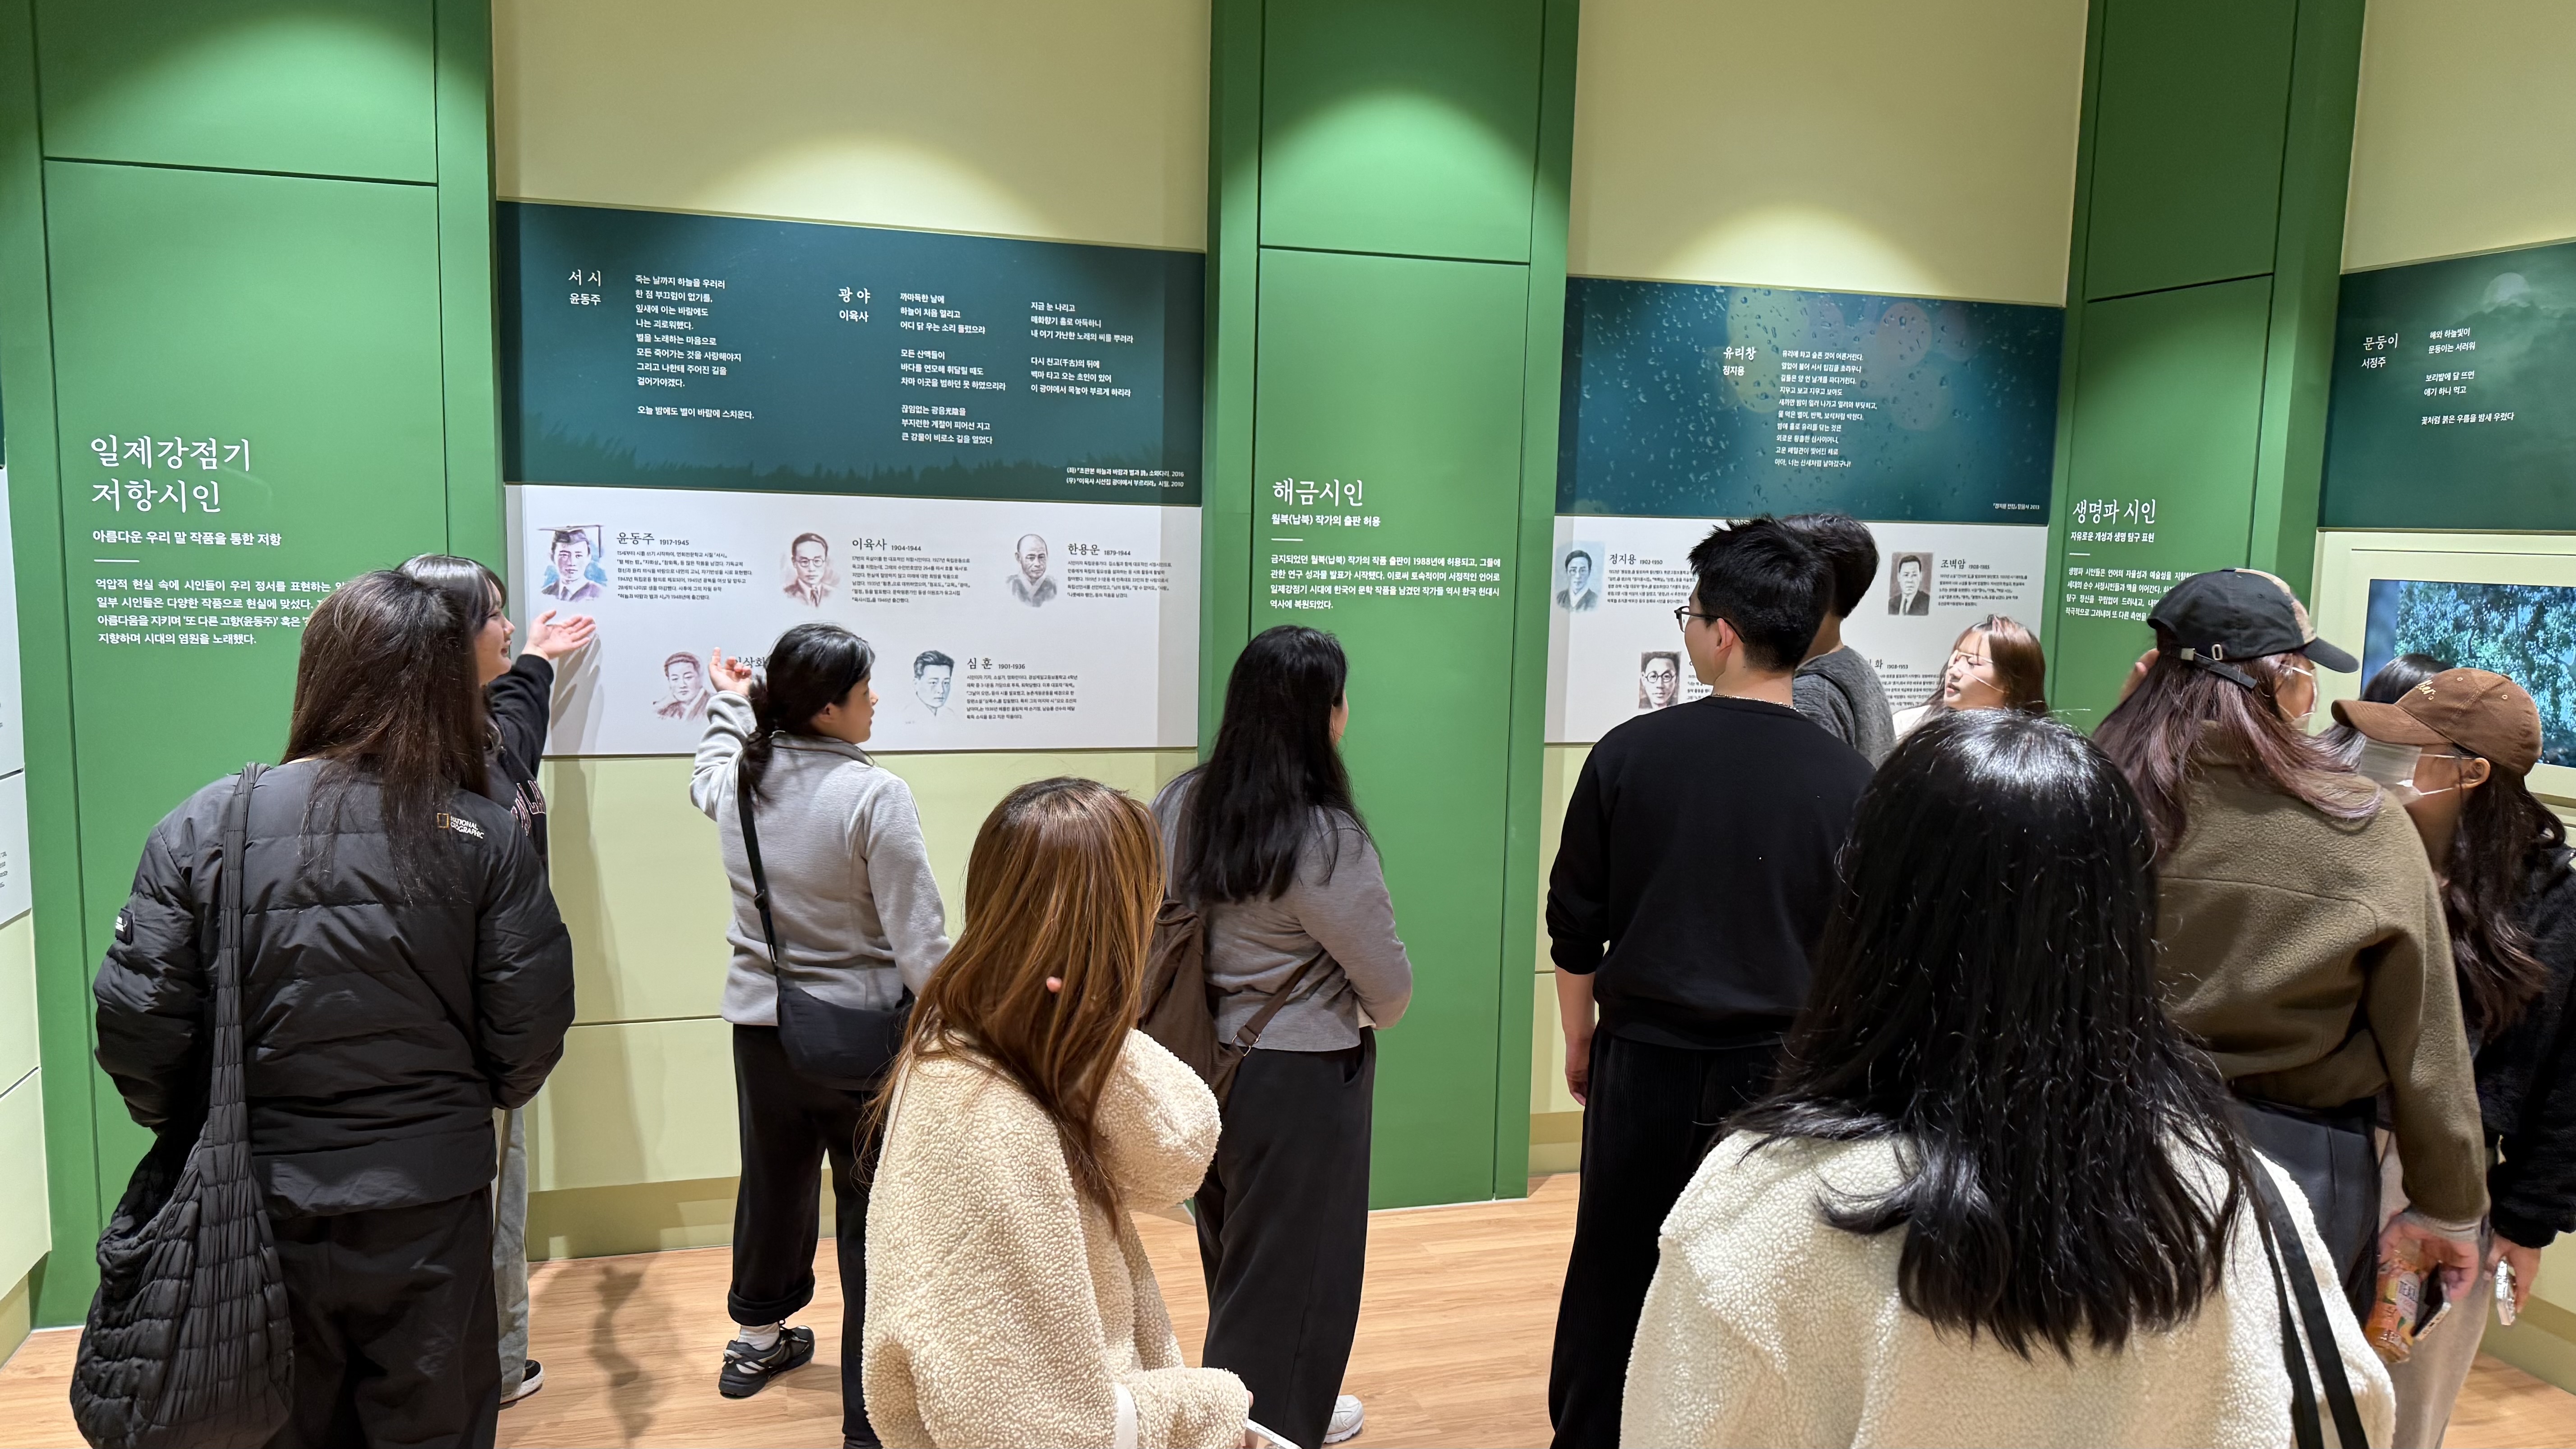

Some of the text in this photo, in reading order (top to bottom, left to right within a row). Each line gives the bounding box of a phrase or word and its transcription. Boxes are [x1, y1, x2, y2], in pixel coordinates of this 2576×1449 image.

[635, 274, 725, 289] 죽는 날까지 하늘을 우러러
[569, 292, 601, 306] 윤동주
[635, 289, 643, 298] 한
[645, 290, 653, 299] 점
[655, 290, 685, 301] 부끄럼이
[900, 292, 944, 304] 까마득한 날에
[635, 304, 708, 316] 잎새에 이는 바람에도
[839, 309, 869, 322] 이육사
[635, 318, 694, 330] 나는 괴로워했다.
[900, 321, 915, 330] 어디
[916, 322, 924, 331] 닭
[925, 322, 940, 331] 우는
[941, 323, 956, 333] 소리
[635, 333, 717, 345] 별을 노래하는 마음으로
[2429, 327, 2470, 339] 해와 하늘빛이
[2363, 332, 2398, 350] 문둥이
[2428, 341, 2475, 354] 문둥이는 서러워
[636, 347, 741, 362] 모든 죽어가는 것을 사랑해야지
[1723, 345, 1757, 361] 유리창
[636, 362, 727, 375] 그리고 나한테 주어진 길을
[1030, 356, 1044, 365] 다시
[1086, 359, 1099, 368] 뒤에
[2361, 356, 2386, 369] 서정주
[1030, 370, 1111, 383] 백마 타고 오는 초인이 있어
[1722, 365, 1745, 376] 정지용
[2425, 370, 2475, 382] 보리밭에 달 뜨면
[637, 376, 685, 387] 걸어가야겠다.
[901, 377, 915, 386] 차마
[917, 377, 938, 387] 이곳을
[939, 378, 961, 388] 범하던
[2438, 386, 2452, 396] 하나
[2453, 386, 2466, 395] 먹고
[637, 405, 754, 419] 오늘 밤에도 별이 바람에 스치운다.
[2421, 415, 2441, 425] 꽃처럼
[2442, 414, 2455, 424] 붉은
[2456, 413, 2476, 423] 우름을
[2478, 413, 2492, 422] 밤새
[91, 434, 249, 472] 일제강점기
[92, 478, 221, 513] 저항시인
[1272, 477, 1362, 507] 해금시인
[2072, 498, 2156, 524] 생명파 시인
[1315, 514, 1341, 526] 작가의
[1343, 515, 1362, 526] 출판
[1363, 515, 1381, 527] 허용
[92, 529, 282, 546] 아름다운 우리 말 작품을 통한 저항
[616, 532, 655, 545] 윤동주
[2070, 531, 2154, 543] 자유로운 개성과 생명 탐구 표현
[852, 537, 887, 551] 이육사
[1067, 543, 1100, 556] 한용운
[1610, 553, 1636, 565] 정지용
[95, 578, 128, 590] 억압적
[132, 579, 154, 590] 현실
[157, 579, 179, 591] 속에
[184, 579, 225, 591] 시인들이
[229, 580, 250, 592] 우리
[255, 580, 286, 592] 정서를
[290, 581, 331, 593] 표현하는
[1270, 584, 1307, 594] 일제강점기
[1309, 584, 1332, 594] 시대에
[1334, 584, 1356, 595] 한국어
[1357, 585, 1373, 595] 문학
[1374, 585, 1397, 595] 작품을
[1398, 585, 1420, 596] 남겼던
[1421, 586, 1444, 596] 작가들
[1445, 586, 1460, 596] 역시
[1462, 586, 1477, 596] 한국
[96, 596, 314, 612] 일부 시인들은 다양한 작품으로 현실에 맞섰다.
[1270, 599, 1333, 609] 역사에 복원되었다.
[97, 614, 149, 626] 아름다움을
[150, 615, 181, 627] 지키며
[198, 615, 219, 627] 다른
[280, 616, 301, 627] 혹은
[98, 632, 257, 645] 지향하며 시대의 염원을 노래했다.
